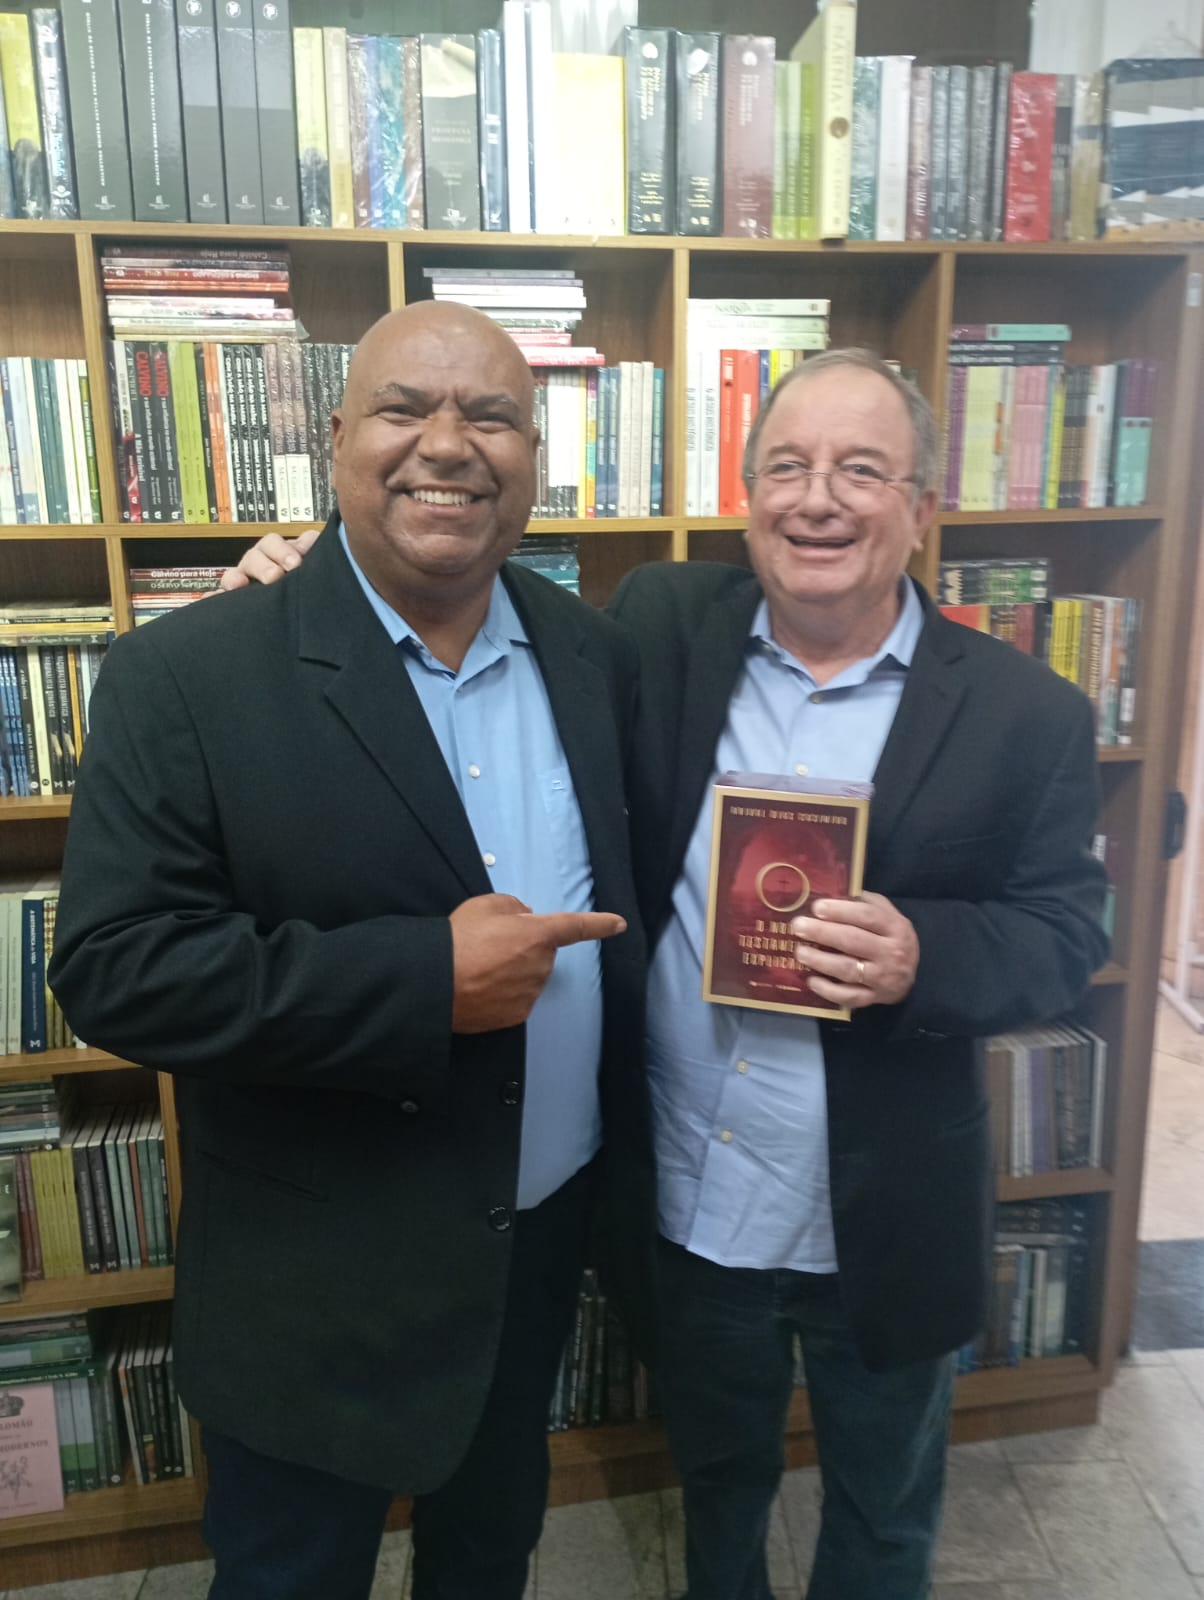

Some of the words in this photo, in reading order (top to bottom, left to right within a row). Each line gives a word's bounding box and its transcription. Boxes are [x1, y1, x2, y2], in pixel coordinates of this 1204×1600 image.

[135, 351, 152, 396] CALVINO
[153, 352, 169, 397] CALVINO
[739, 934, 796, 952] TESTAME
[743, 951, 810, 971] EXPLICA
